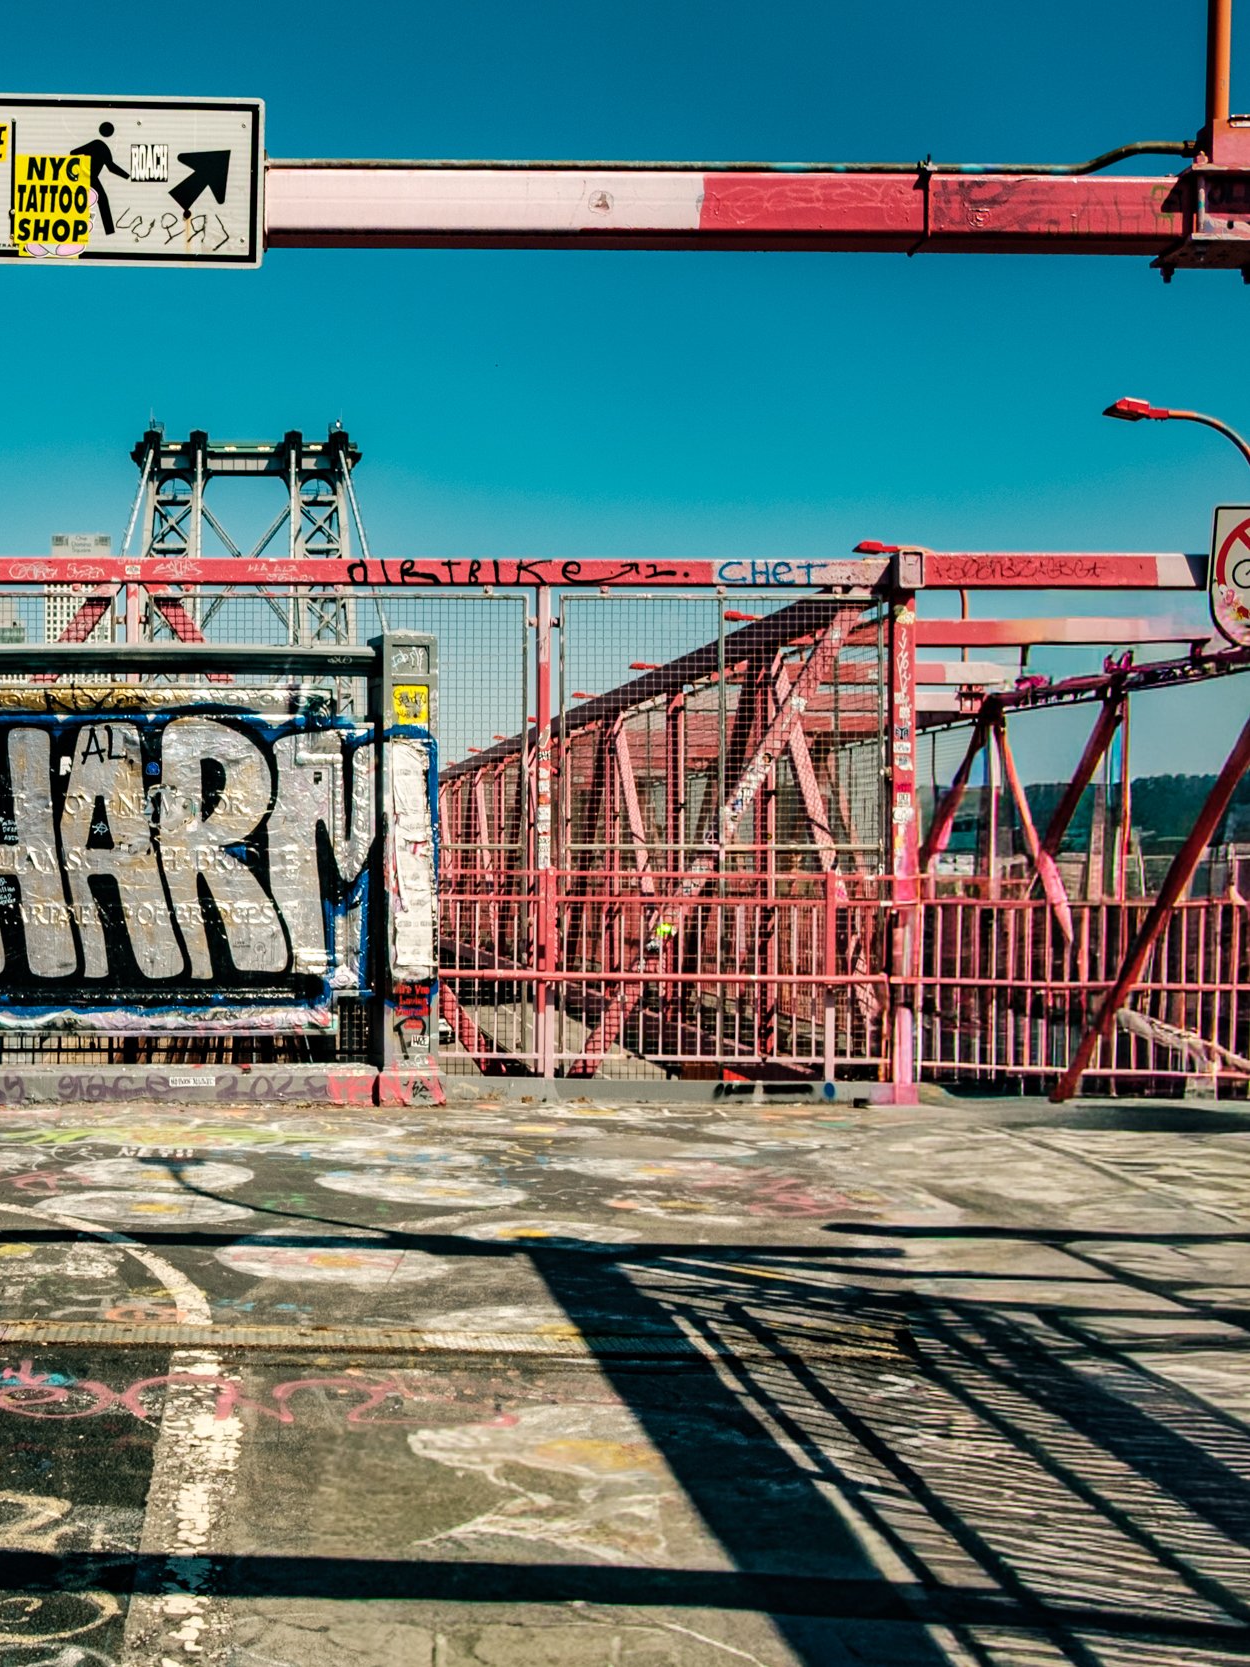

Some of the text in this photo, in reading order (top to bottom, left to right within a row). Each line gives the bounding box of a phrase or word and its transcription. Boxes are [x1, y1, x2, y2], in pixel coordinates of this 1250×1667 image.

[27, 157, 81, 182] NYC
[131, 144, 168, 181] ROACH
[17, 184, 88, 214] TATTOO
[17, 218, 88, 242] SHOP
